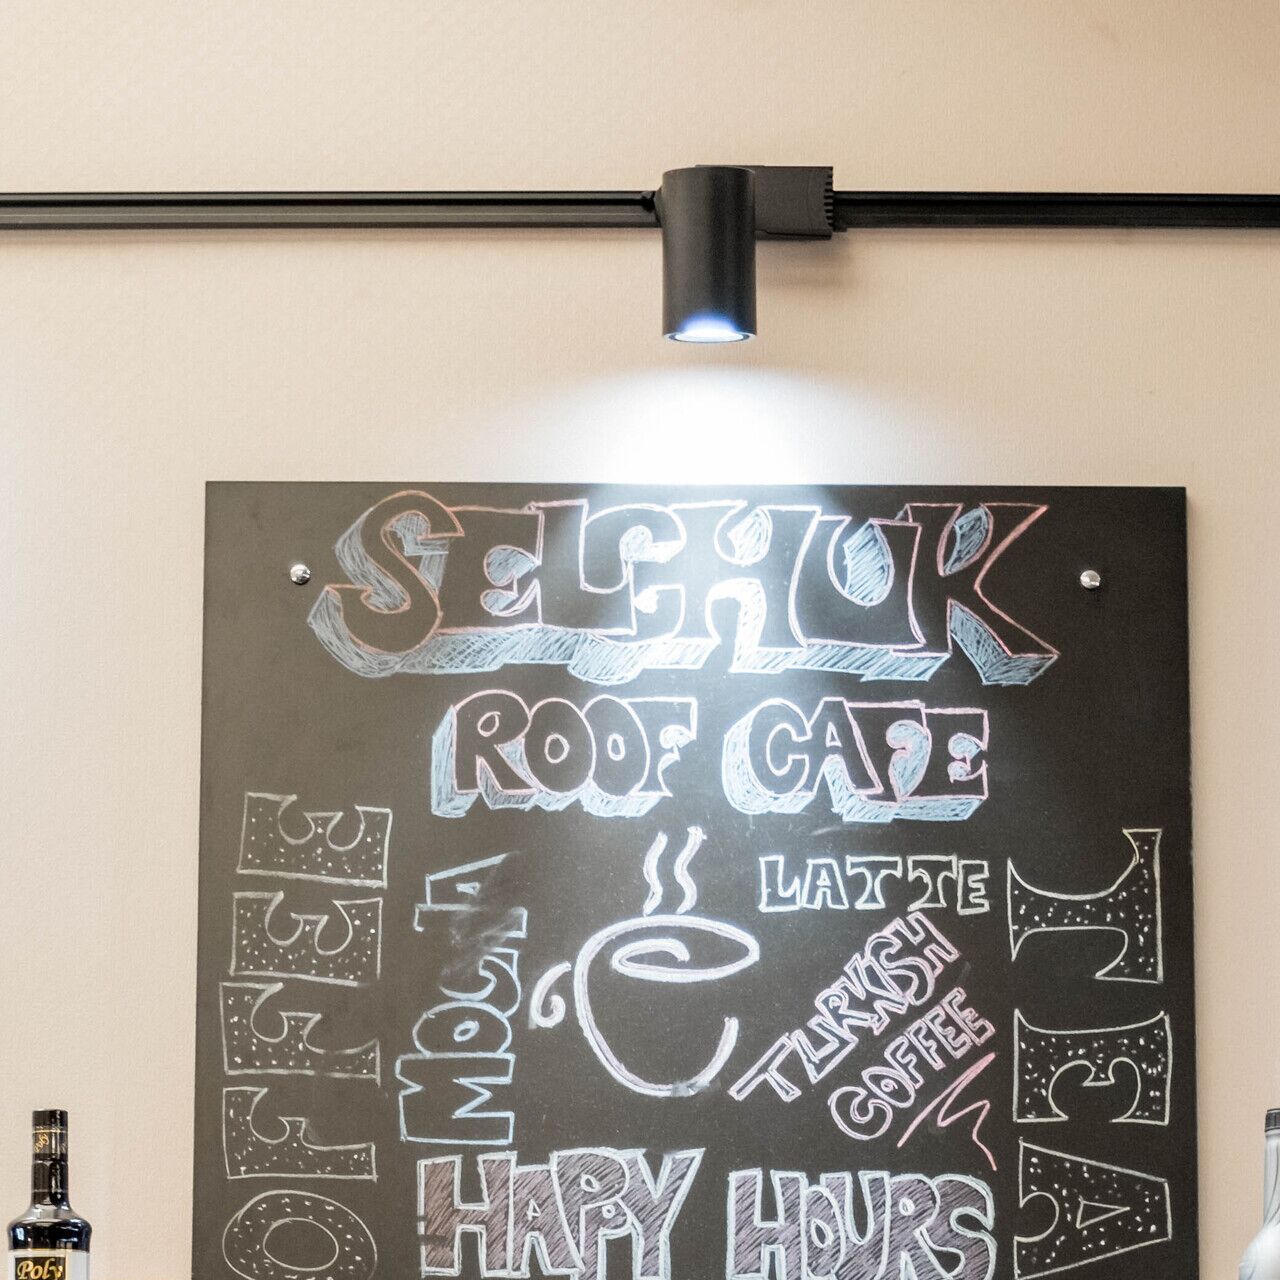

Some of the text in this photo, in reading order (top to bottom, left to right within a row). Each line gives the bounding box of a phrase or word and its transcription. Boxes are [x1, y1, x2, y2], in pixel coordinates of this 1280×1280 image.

[308, 490, 1060, 684] SELCHUK
[431, 690, 988, 822] ROOF CAFE
[758, 855, 991, 916] LATTE
[727, 910, 961, 1103] TURKISH
[826, 986, 997, 1141] COFFEE
[1007, 828, 1174, 1280] TEA
